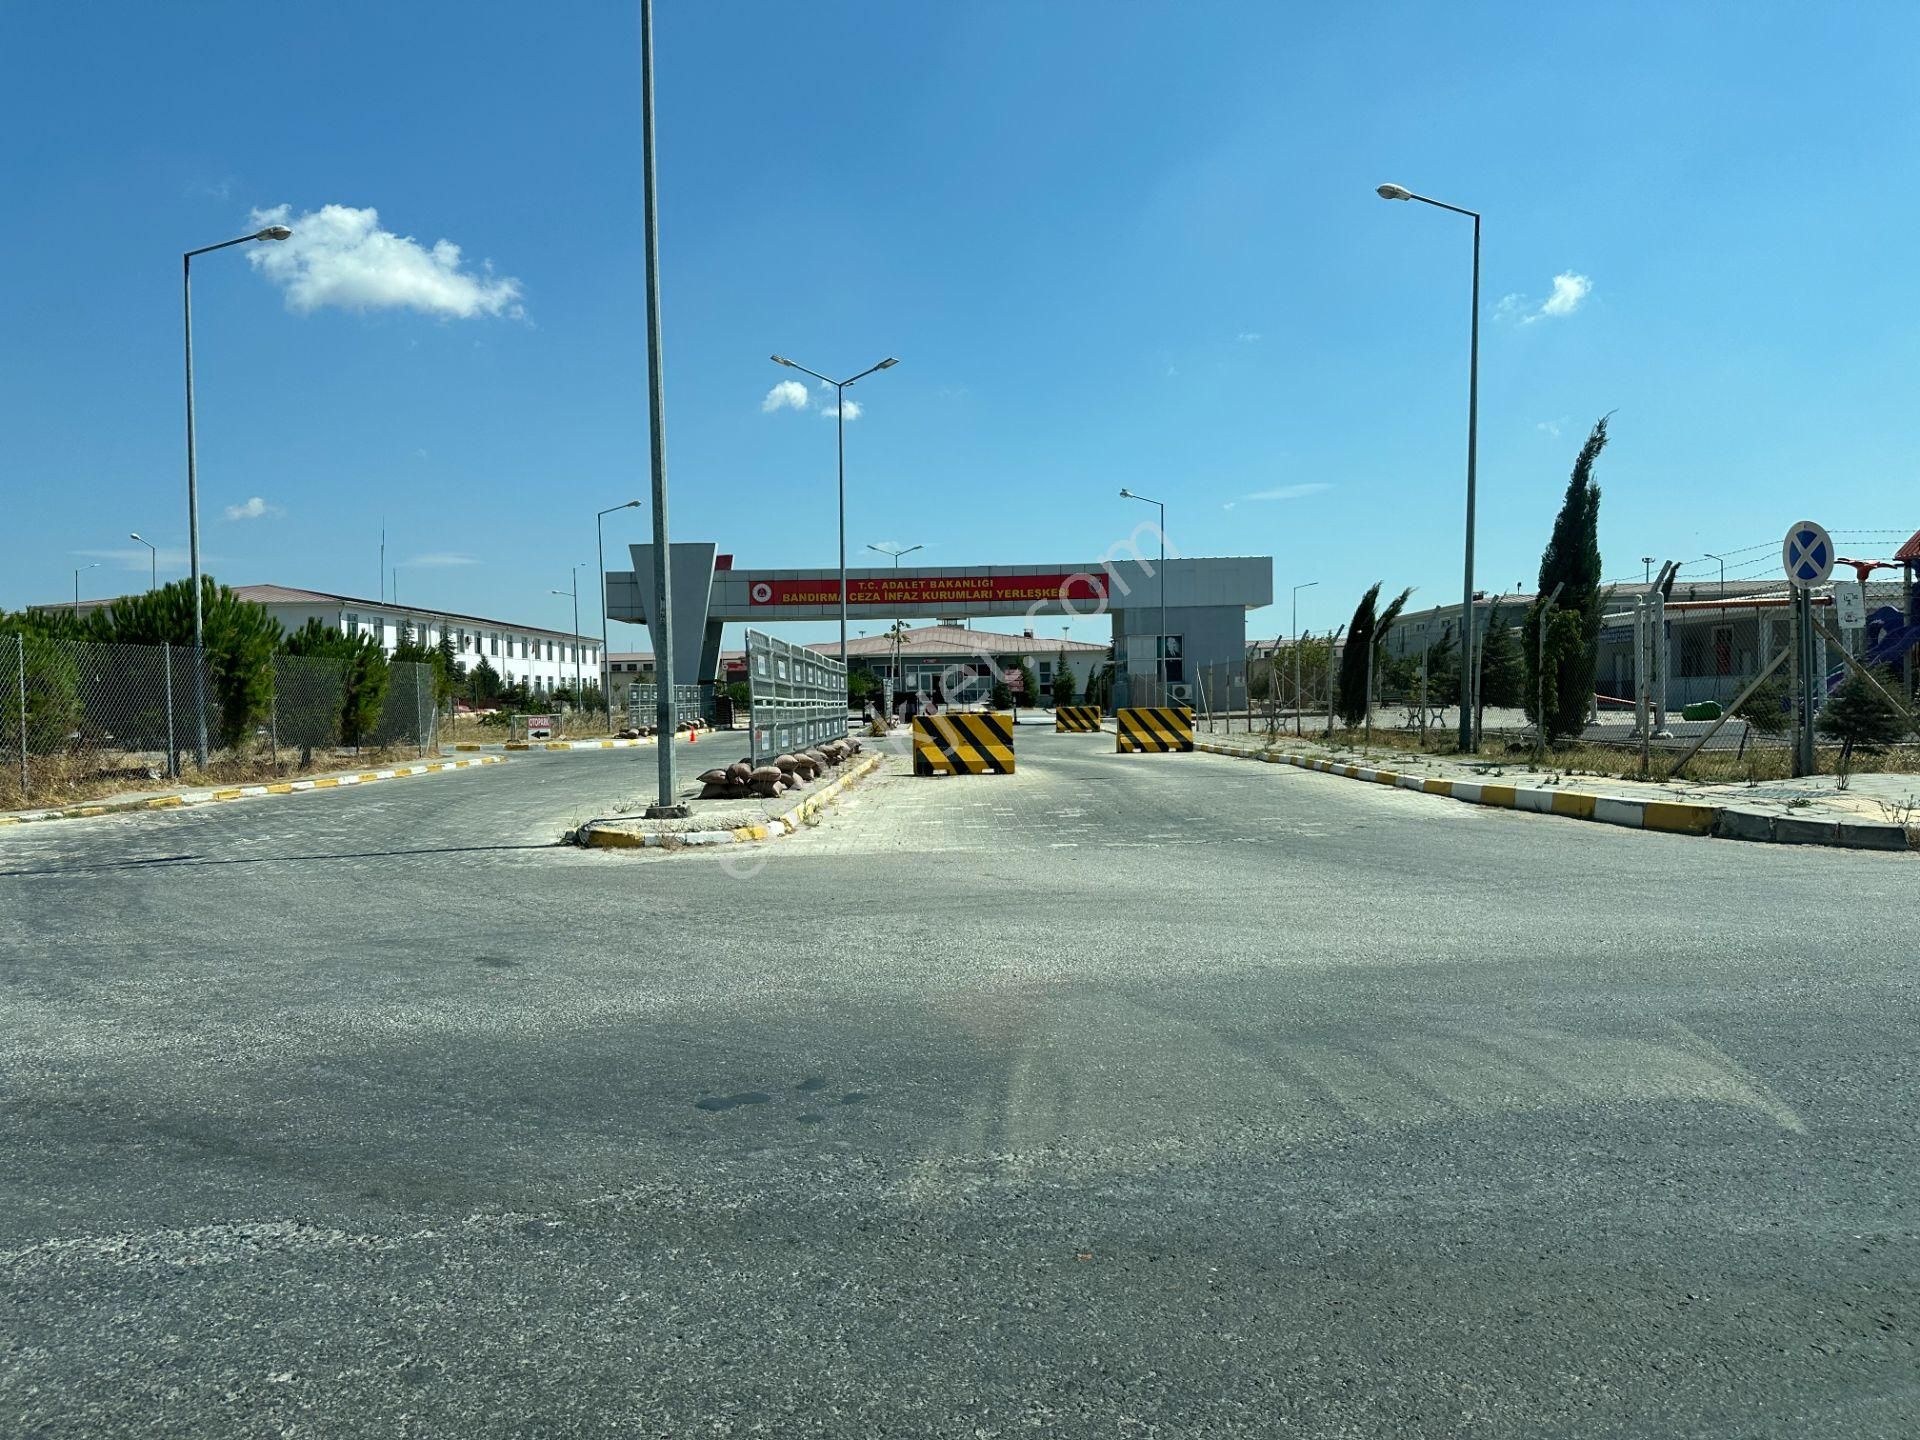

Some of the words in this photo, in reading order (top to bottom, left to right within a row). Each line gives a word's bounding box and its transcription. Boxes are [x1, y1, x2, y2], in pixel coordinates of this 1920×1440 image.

[858, 581, 878, 590] T.C.
[882, 581, 925, 590] ADALET
[850, 592, 880, 601] CEZA
[884, 590, 918, 600] İNFAZ
[923, 590, 992, 600] KURUMLARI
